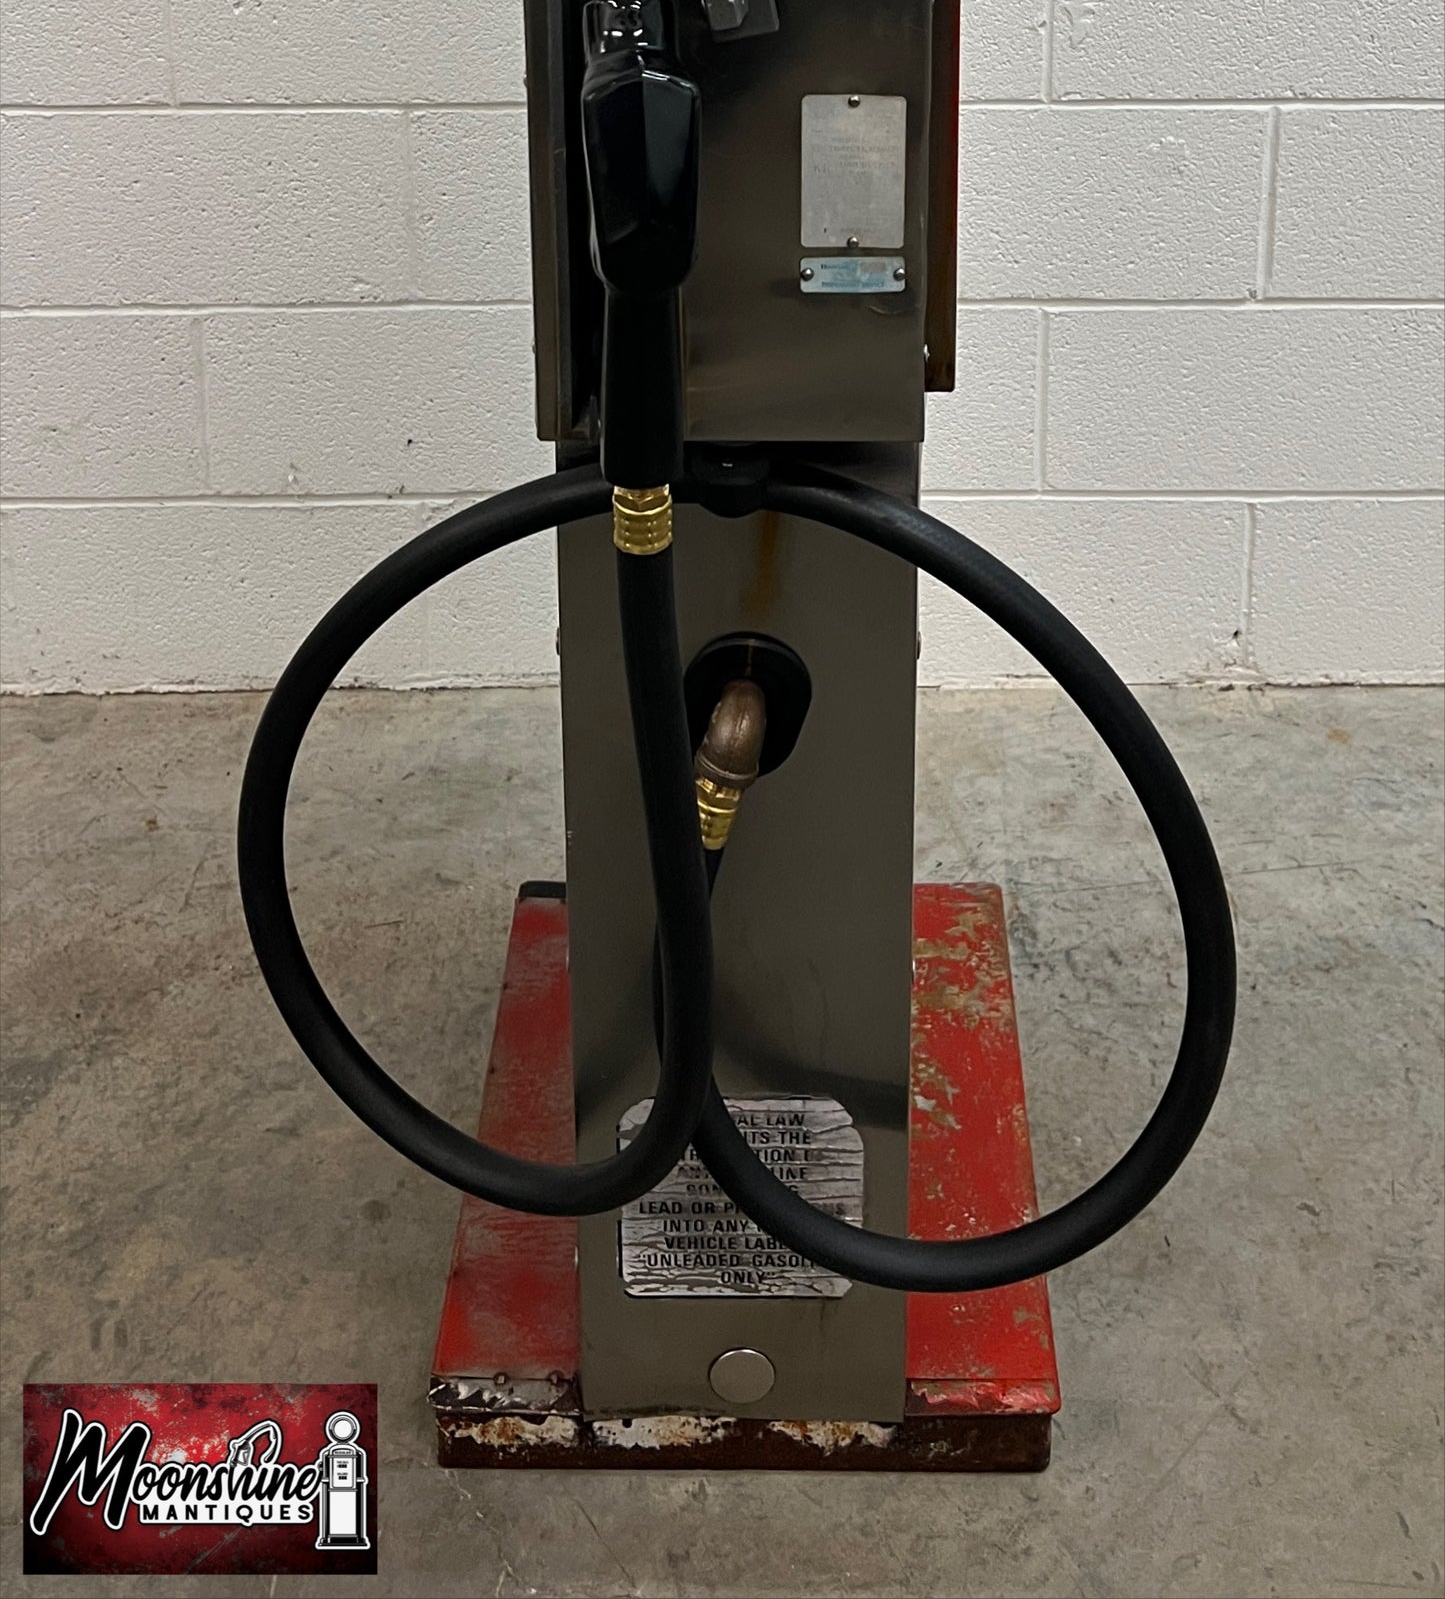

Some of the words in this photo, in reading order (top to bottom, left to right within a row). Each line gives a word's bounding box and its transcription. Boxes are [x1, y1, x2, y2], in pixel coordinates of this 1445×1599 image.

[766, 1112, 805, 1126] LAW
[777, 1131, 811, 1145] THE
[639, 1201, 682, 1215] LEAD
[690, 1201, 715, 1215] OR
[663, 1219, 705, 1233] INTO
[713, 1219, 749, 1233] ANY
[664, 1235, 738, 1250] VEHICLE
